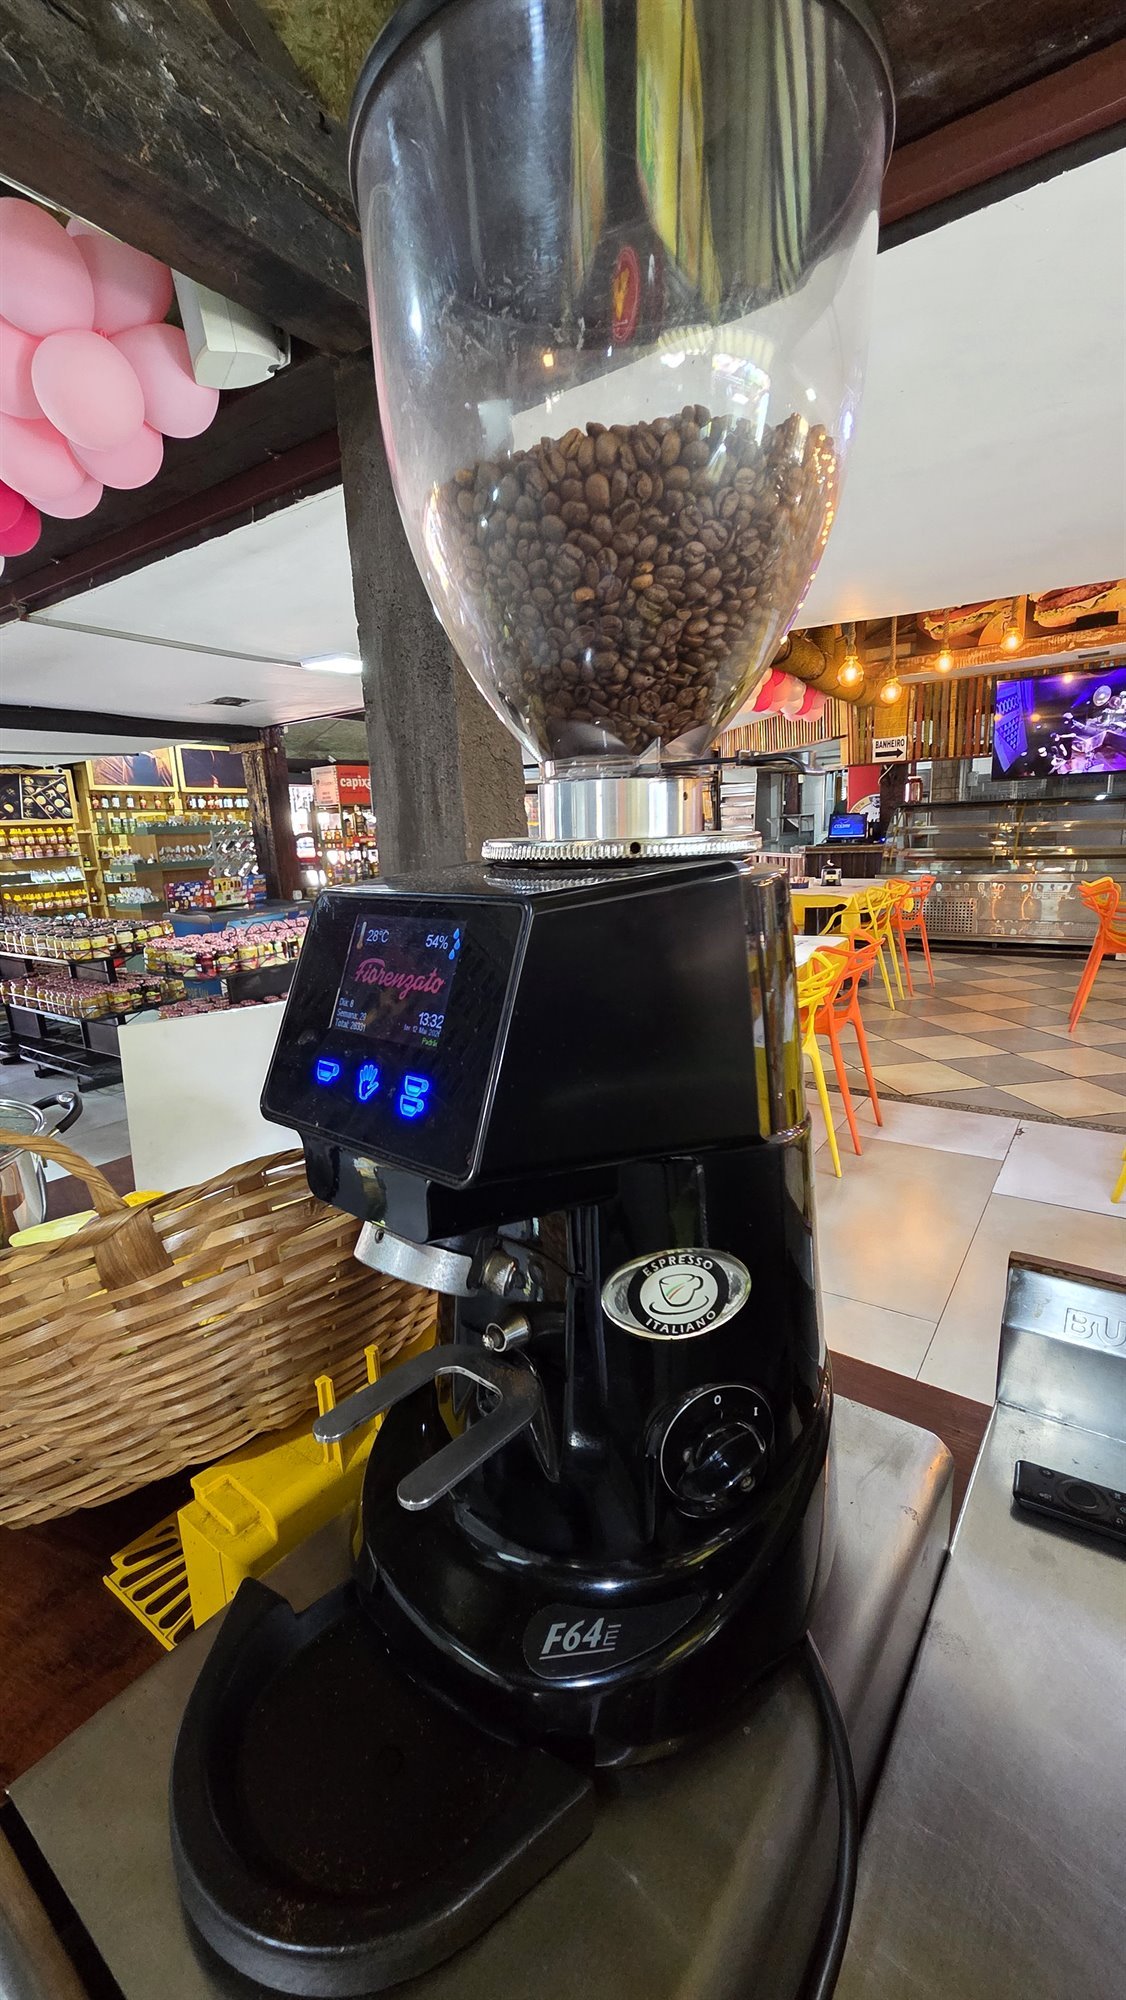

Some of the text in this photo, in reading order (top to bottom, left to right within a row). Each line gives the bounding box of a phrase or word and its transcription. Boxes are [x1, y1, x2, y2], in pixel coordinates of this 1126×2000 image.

[875, 738, 905, 748] BANHEIRO
[366, 929, 389, 943] 28°C
[425, 934, 449, 950] 54%
[354, 957, 446, 1000] Fiorenzato
[418, 1011, 445, 1029] 13:32
[642, 1253, 714, 1278] ESPRESSO
[645, 1310, 717, 1335] ITALIANO
[541, 1617, 622, 1655] F64E
